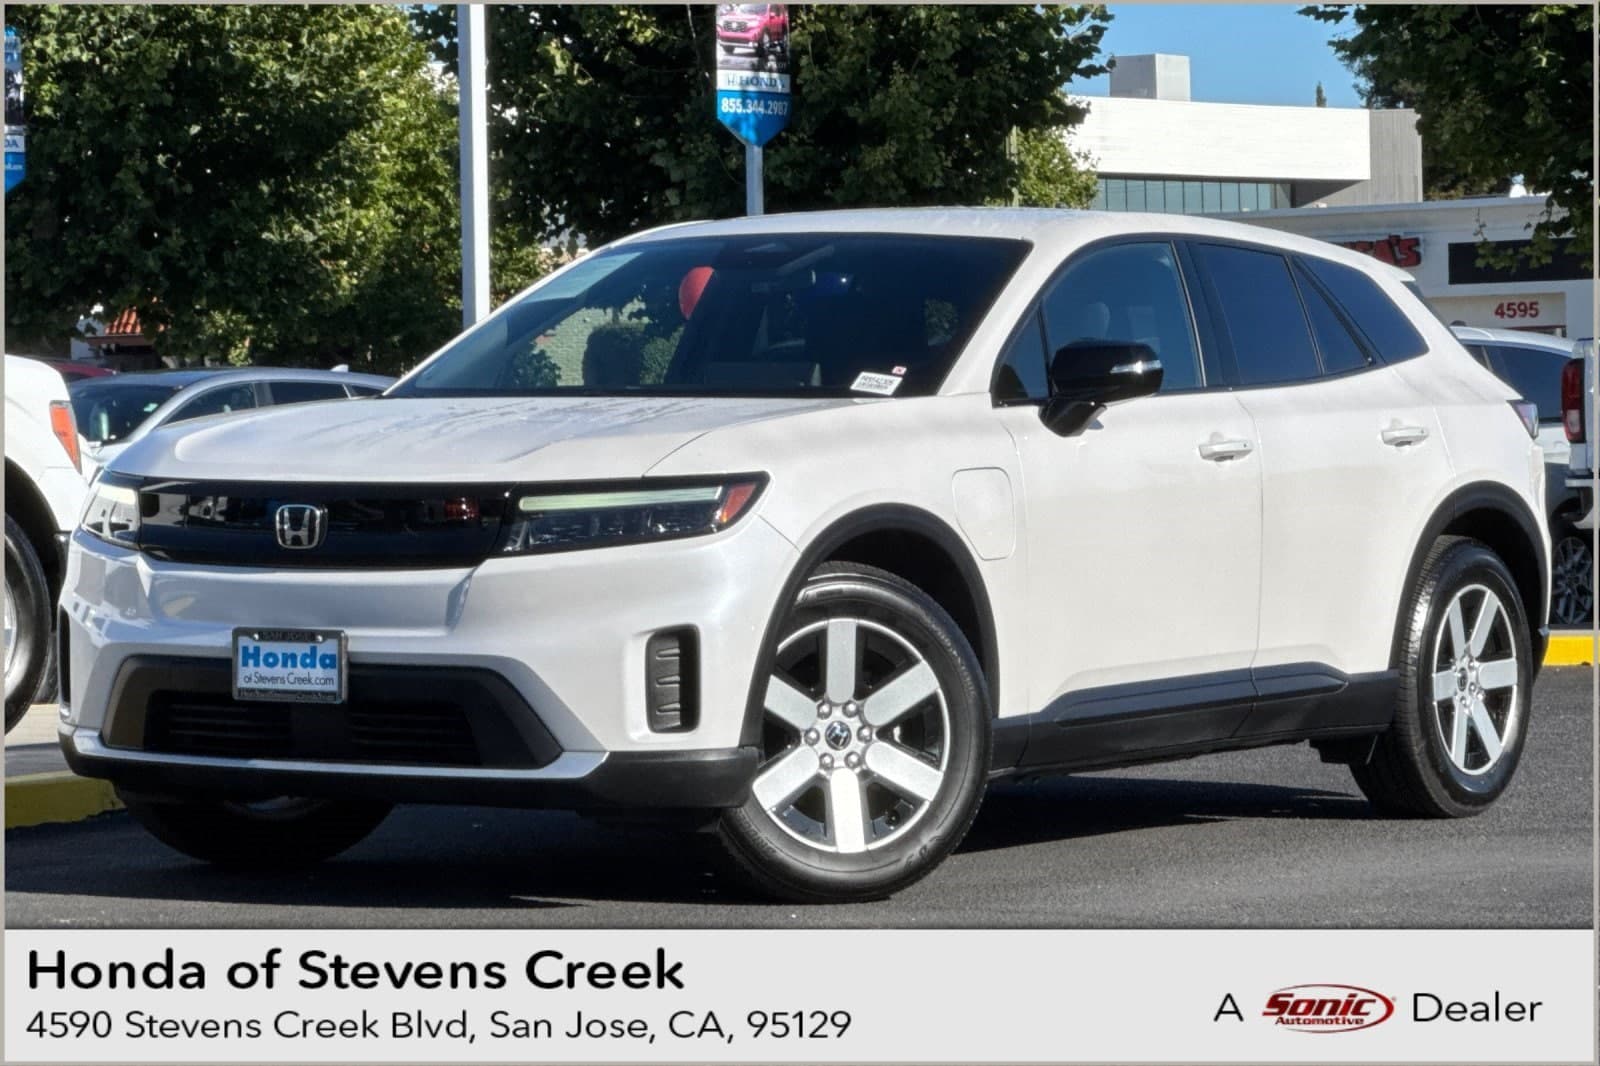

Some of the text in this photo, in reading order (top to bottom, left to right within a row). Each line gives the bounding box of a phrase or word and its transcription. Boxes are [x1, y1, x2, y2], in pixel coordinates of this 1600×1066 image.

[1494, 301, 1540, 319] 4595
[241, 645, 337, 670] Honda
[254, 671, 285, 685] Stevens
